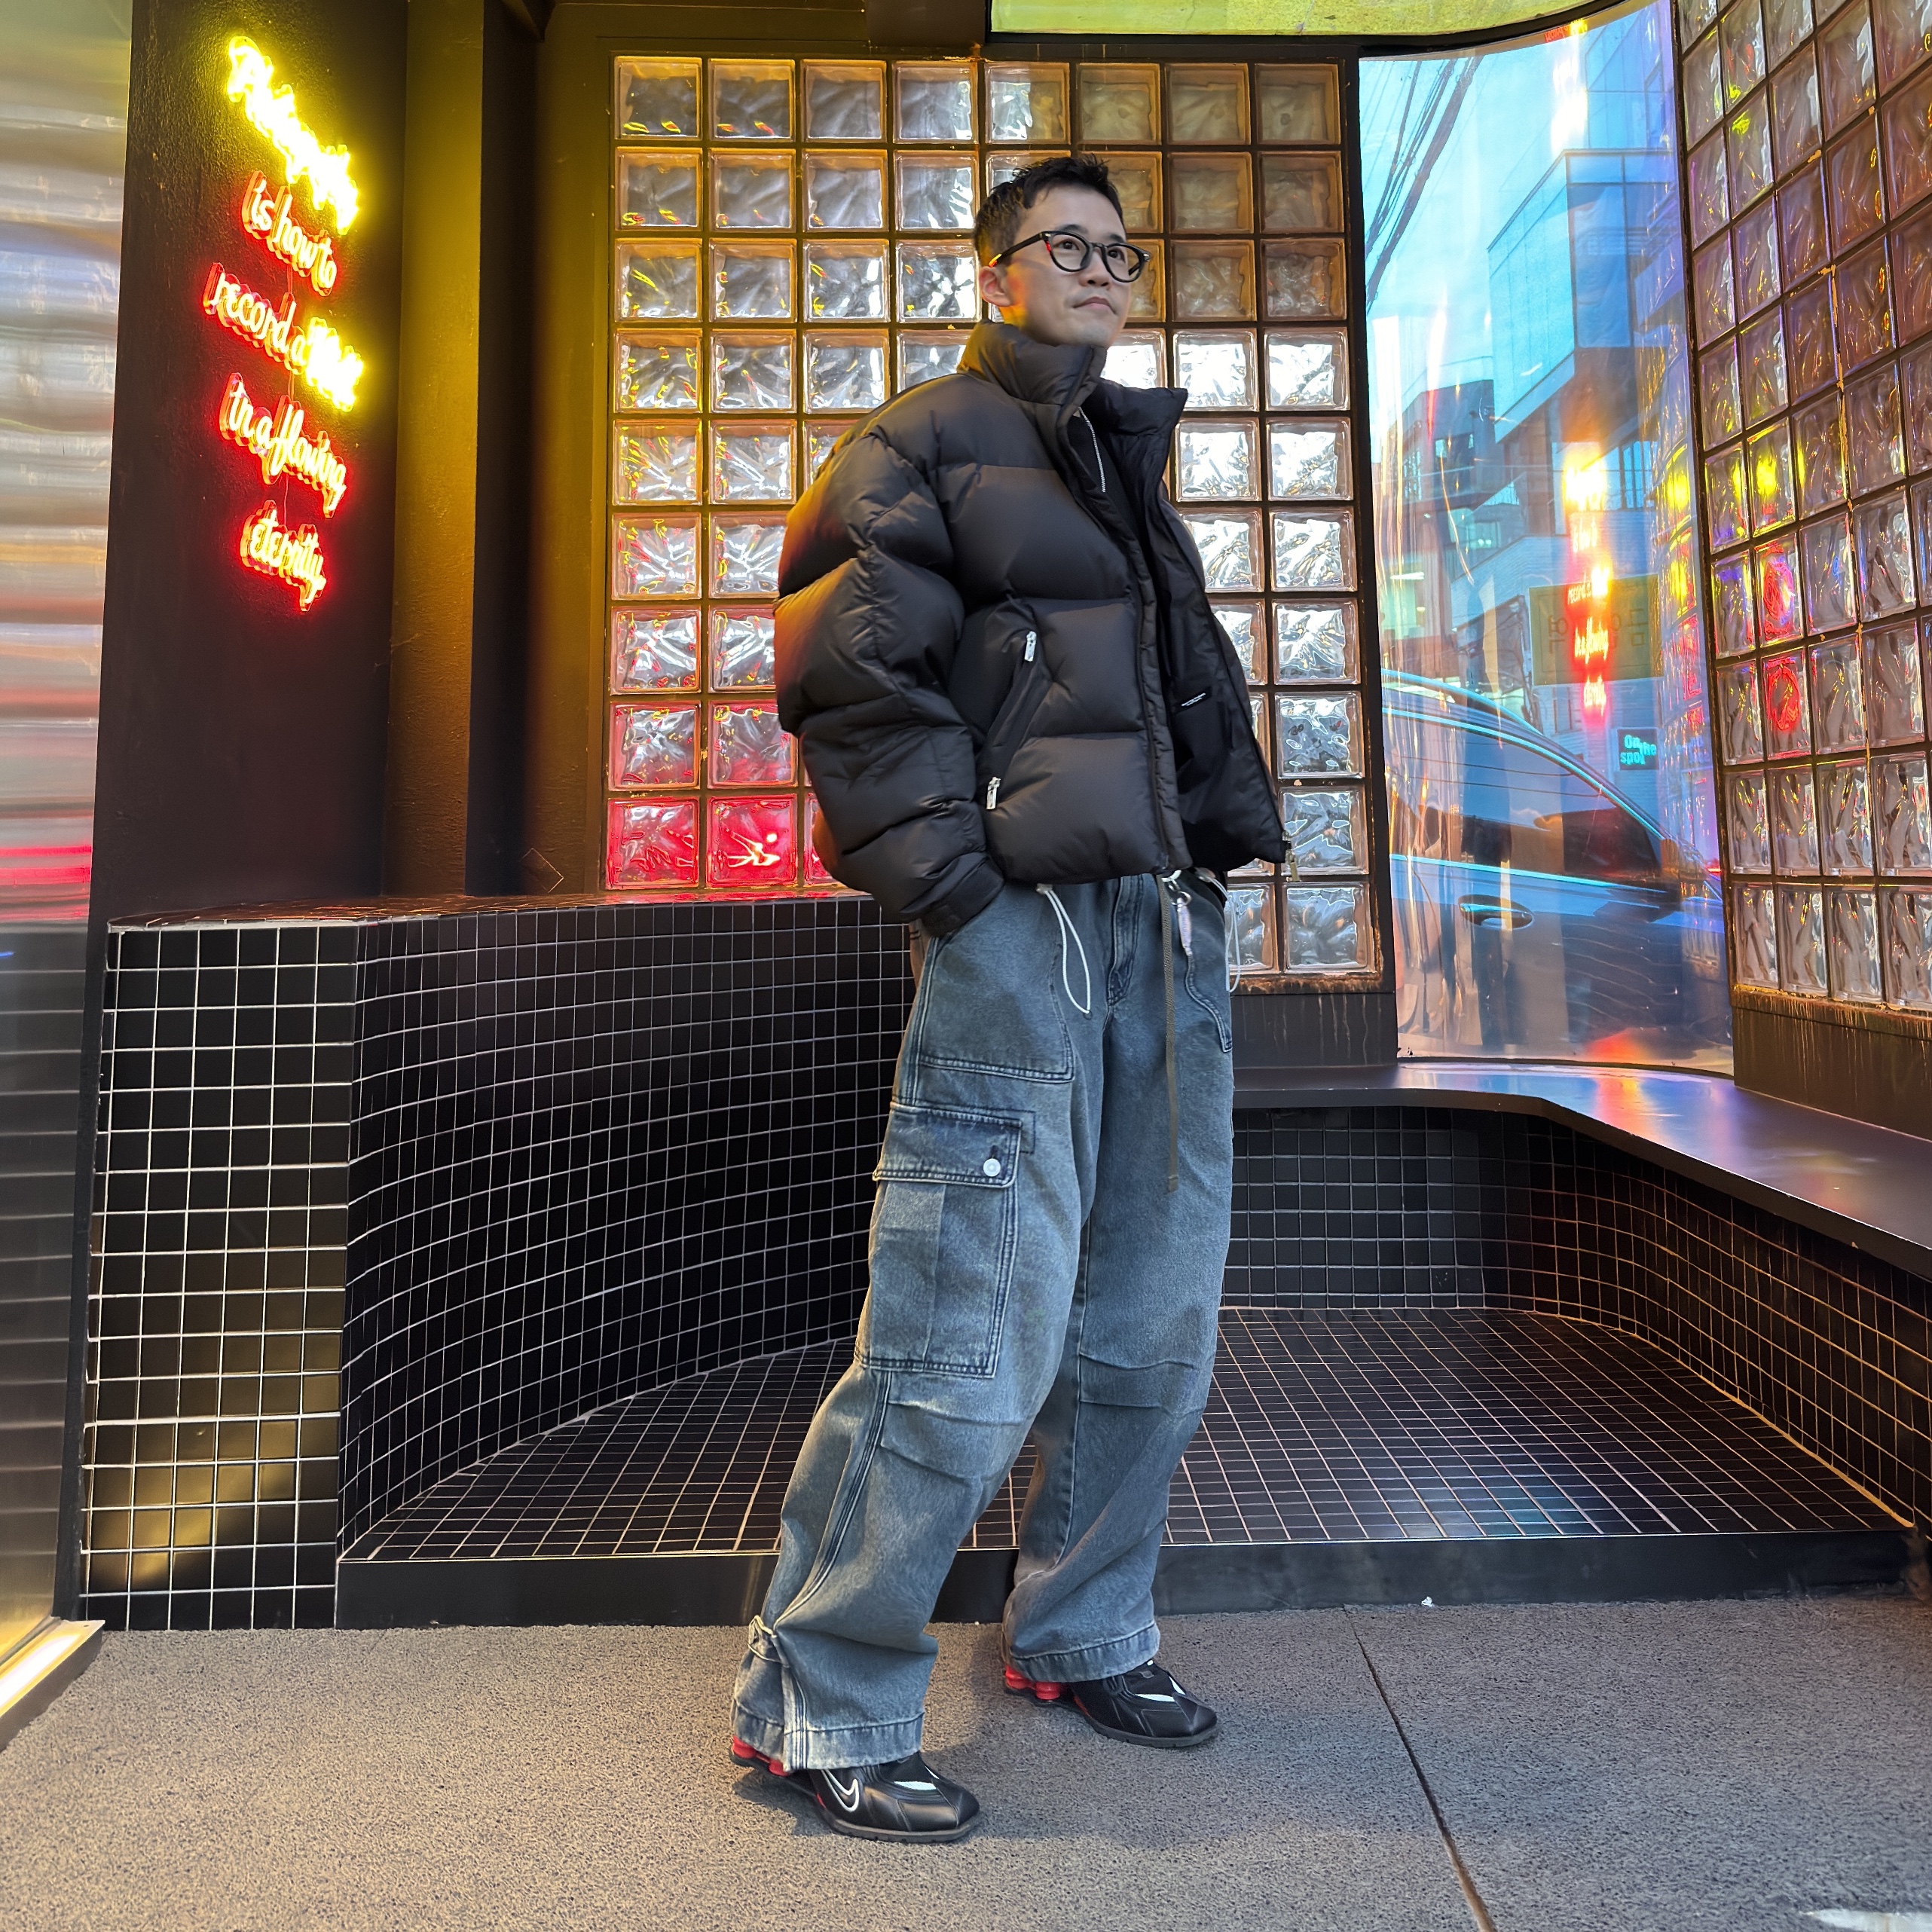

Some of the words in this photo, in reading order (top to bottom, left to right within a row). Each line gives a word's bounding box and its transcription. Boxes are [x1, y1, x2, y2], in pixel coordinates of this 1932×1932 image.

[247, 175, 276, 234] is
[270, 191, 319, 270] how
[316, 233, 337, 290] to
[206, 267, 297, 356] record
[225, 378, 255, 439] in
[255, 414, 274, 451] a
[267, 401, 347, 512] flowing
